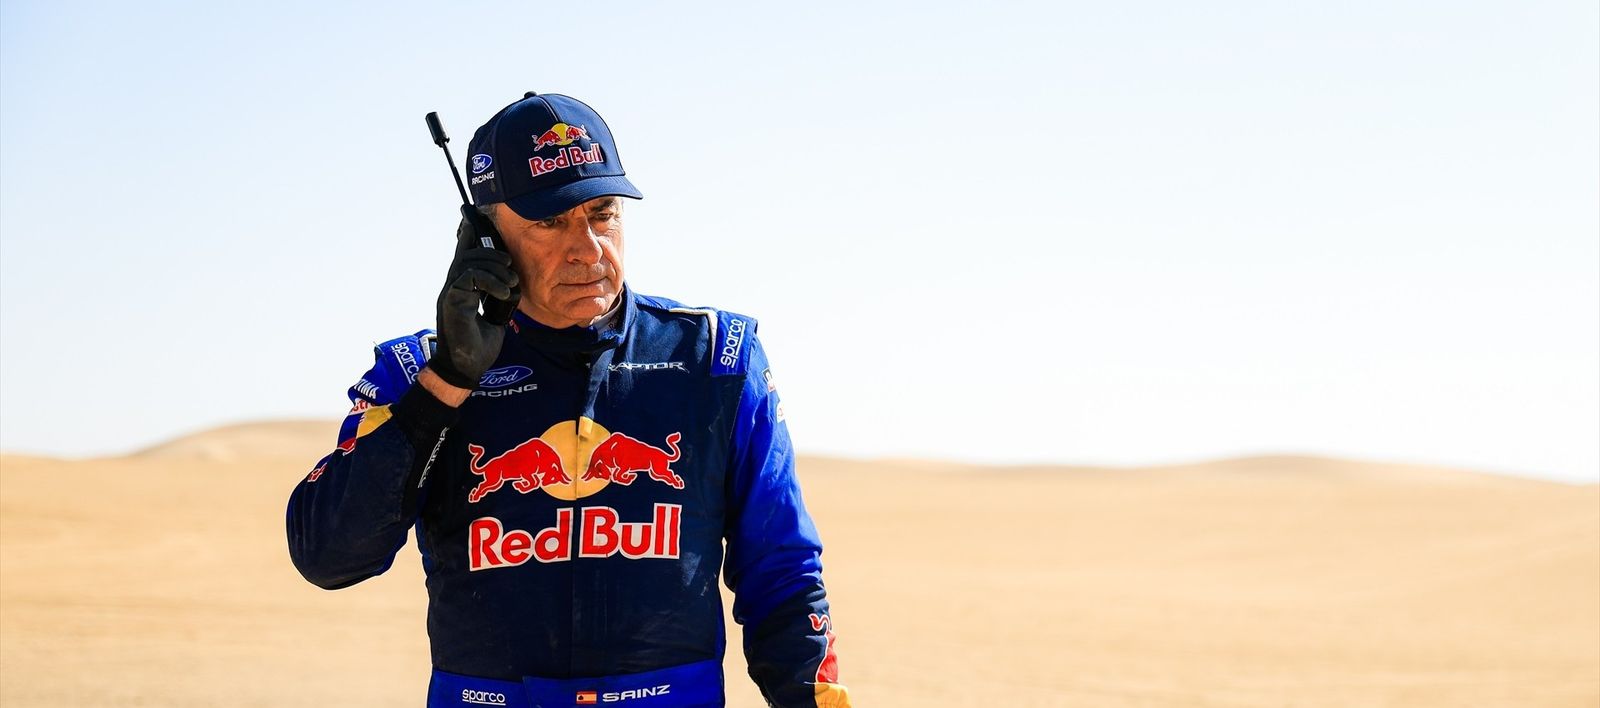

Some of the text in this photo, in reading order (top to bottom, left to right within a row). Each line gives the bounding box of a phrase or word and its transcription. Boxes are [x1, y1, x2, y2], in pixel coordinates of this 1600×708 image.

[529, 143, 603, 177] Red Bull
[471, 171, 495, 185] RACING
[720, 319, 746, 369] sparco
[479, 368, 520, 385] Ford
[471, 383, 538, 397] ACING
[469, 503, 682, 571] Red Bull
[462, 689, 507, 706] sparco
[602, 684, 671, 703] SAINZ
